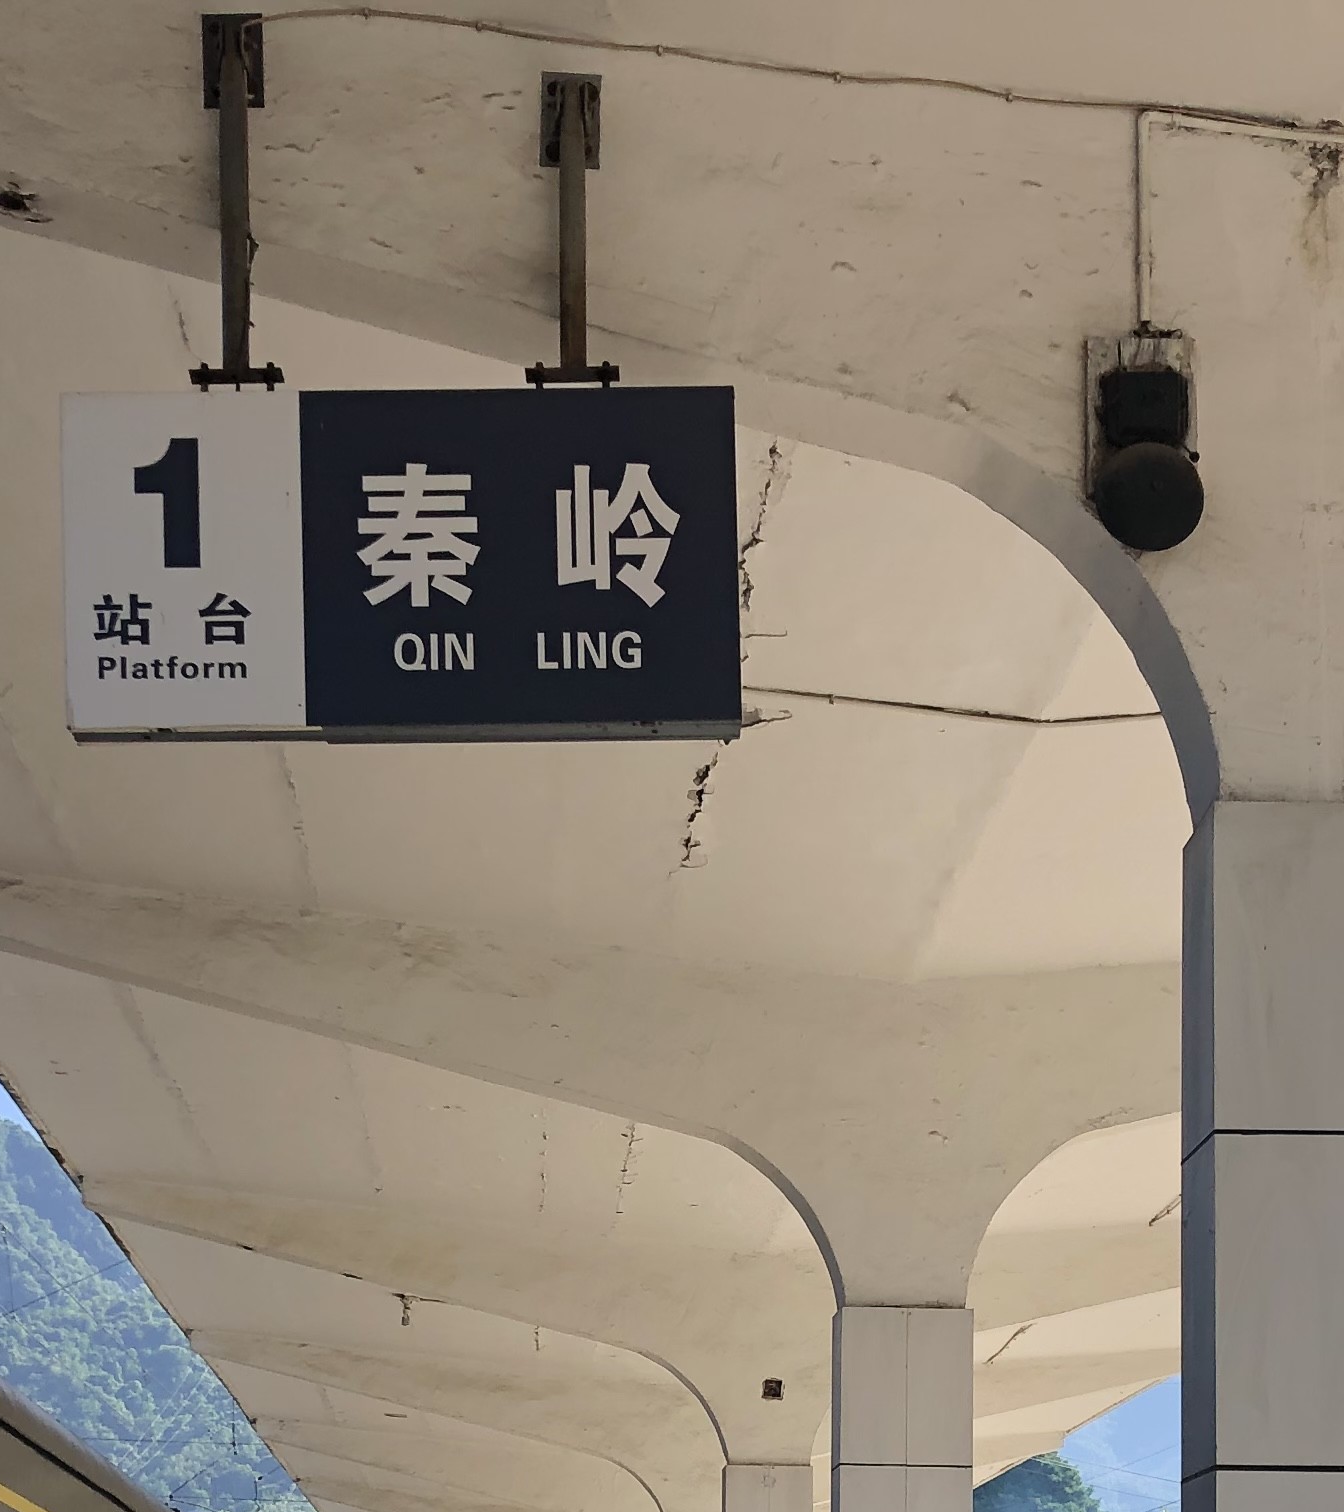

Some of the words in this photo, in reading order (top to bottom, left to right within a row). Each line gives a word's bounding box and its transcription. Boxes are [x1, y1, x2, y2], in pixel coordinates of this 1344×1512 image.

[134, 438, 201, 568] 1
[356, 463, 680, 608] 秦岭
[94, 593, 252, 646] 站台
[97, 655, 248, 680] Platform
[394, 632, 475, 671] QIN
[537, 631, 642, 670] LING
